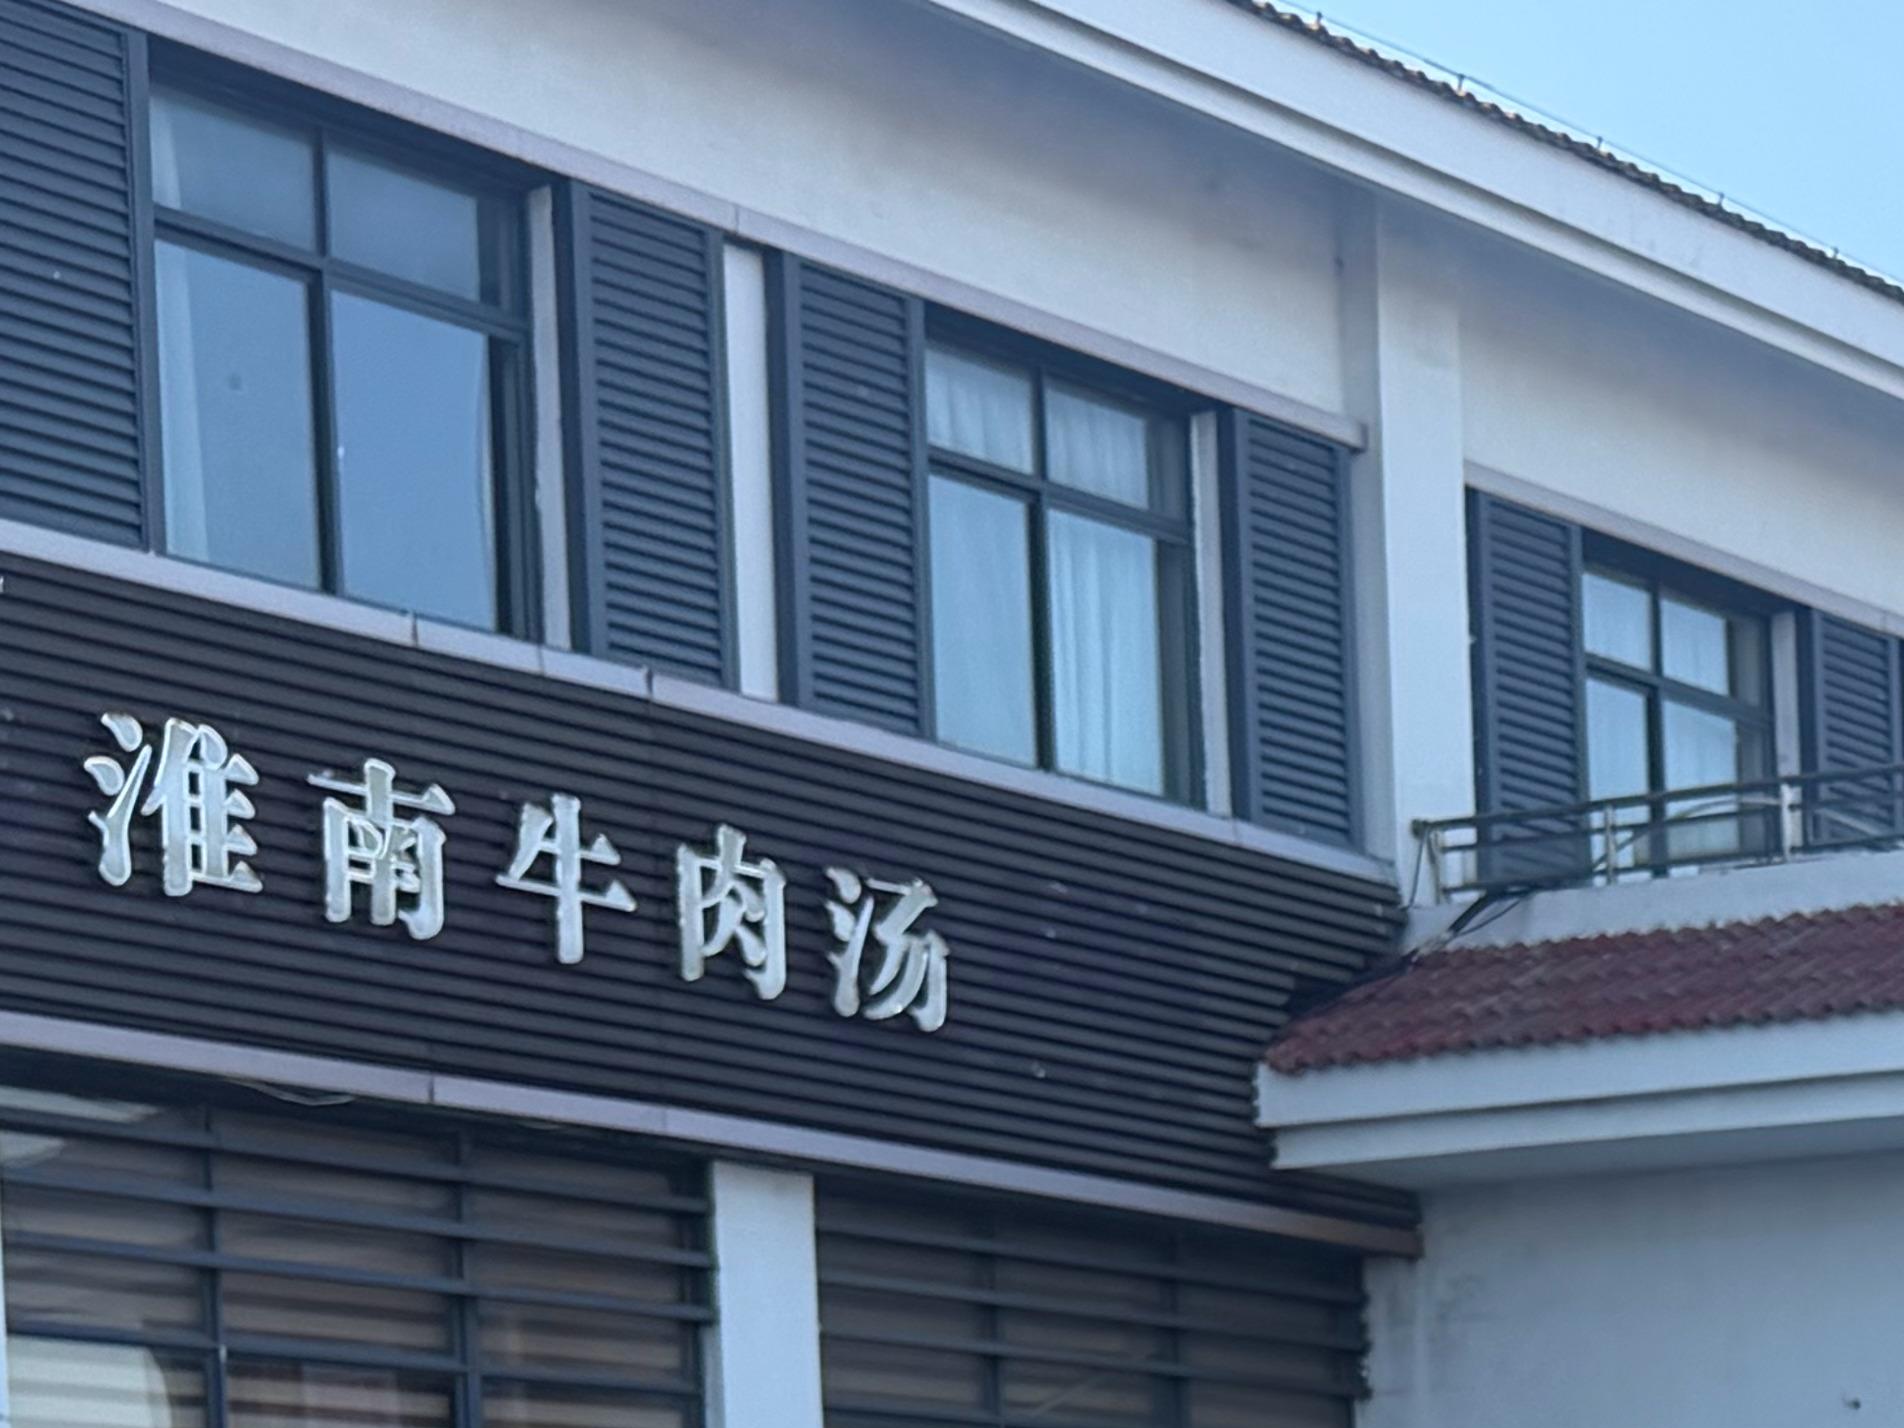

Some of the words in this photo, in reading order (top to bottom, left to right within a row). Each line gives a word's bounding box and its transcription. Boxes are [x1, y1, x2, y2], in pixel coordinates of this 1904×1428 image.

[84, 711, 950, 1034] 淮南牛肉汤
